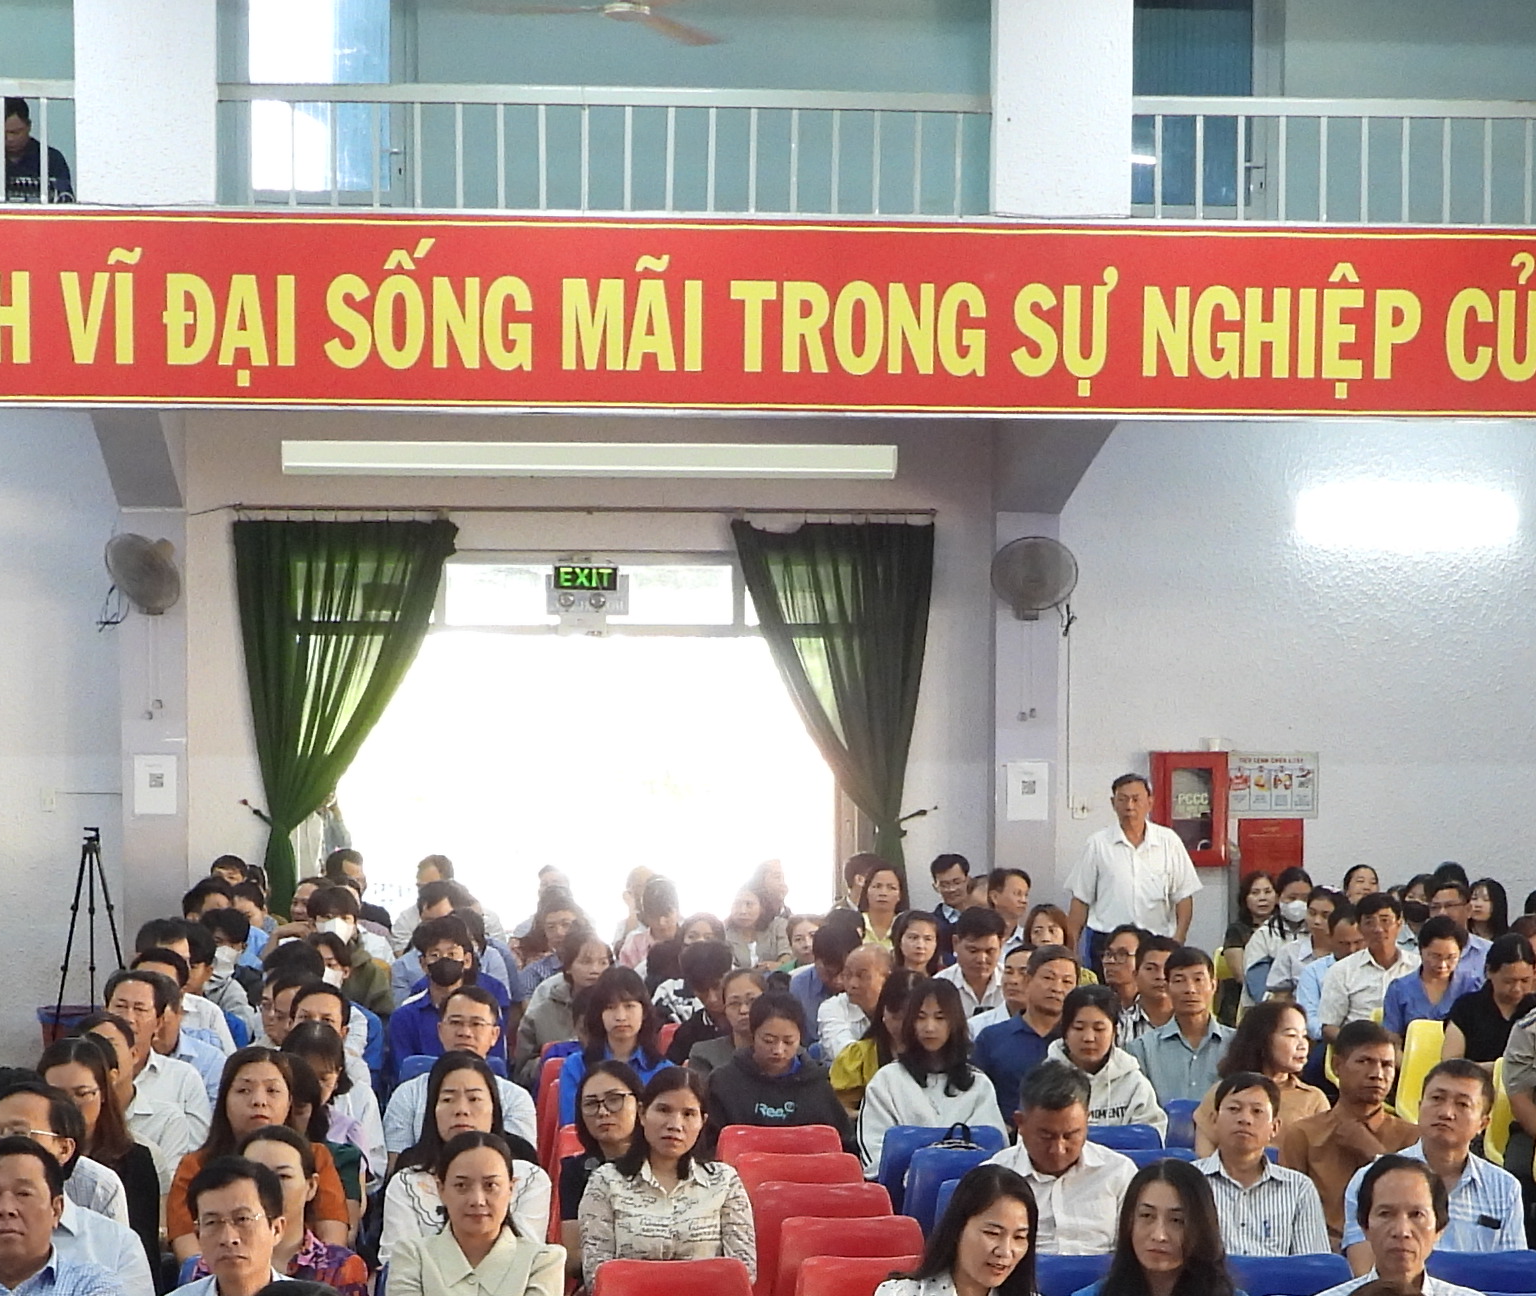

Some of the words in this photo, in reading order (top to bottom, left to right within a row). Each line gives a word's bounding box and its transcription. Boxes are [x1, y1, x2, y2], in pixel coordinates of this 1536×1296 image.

[60, 247, 143, 365] VĨ
[161, 272, 297, 387] ĐẠI
[324, 238, 534, 371] SỐNG
[561, 254, 705, 373] MÃI
[730, 280, 988, 377] TRONG
[1011, 266, 1120, 397] SỰ
[1142, 262, 1422, 399] NGHIỆP
[559, 567, 613, 588] EXIT
